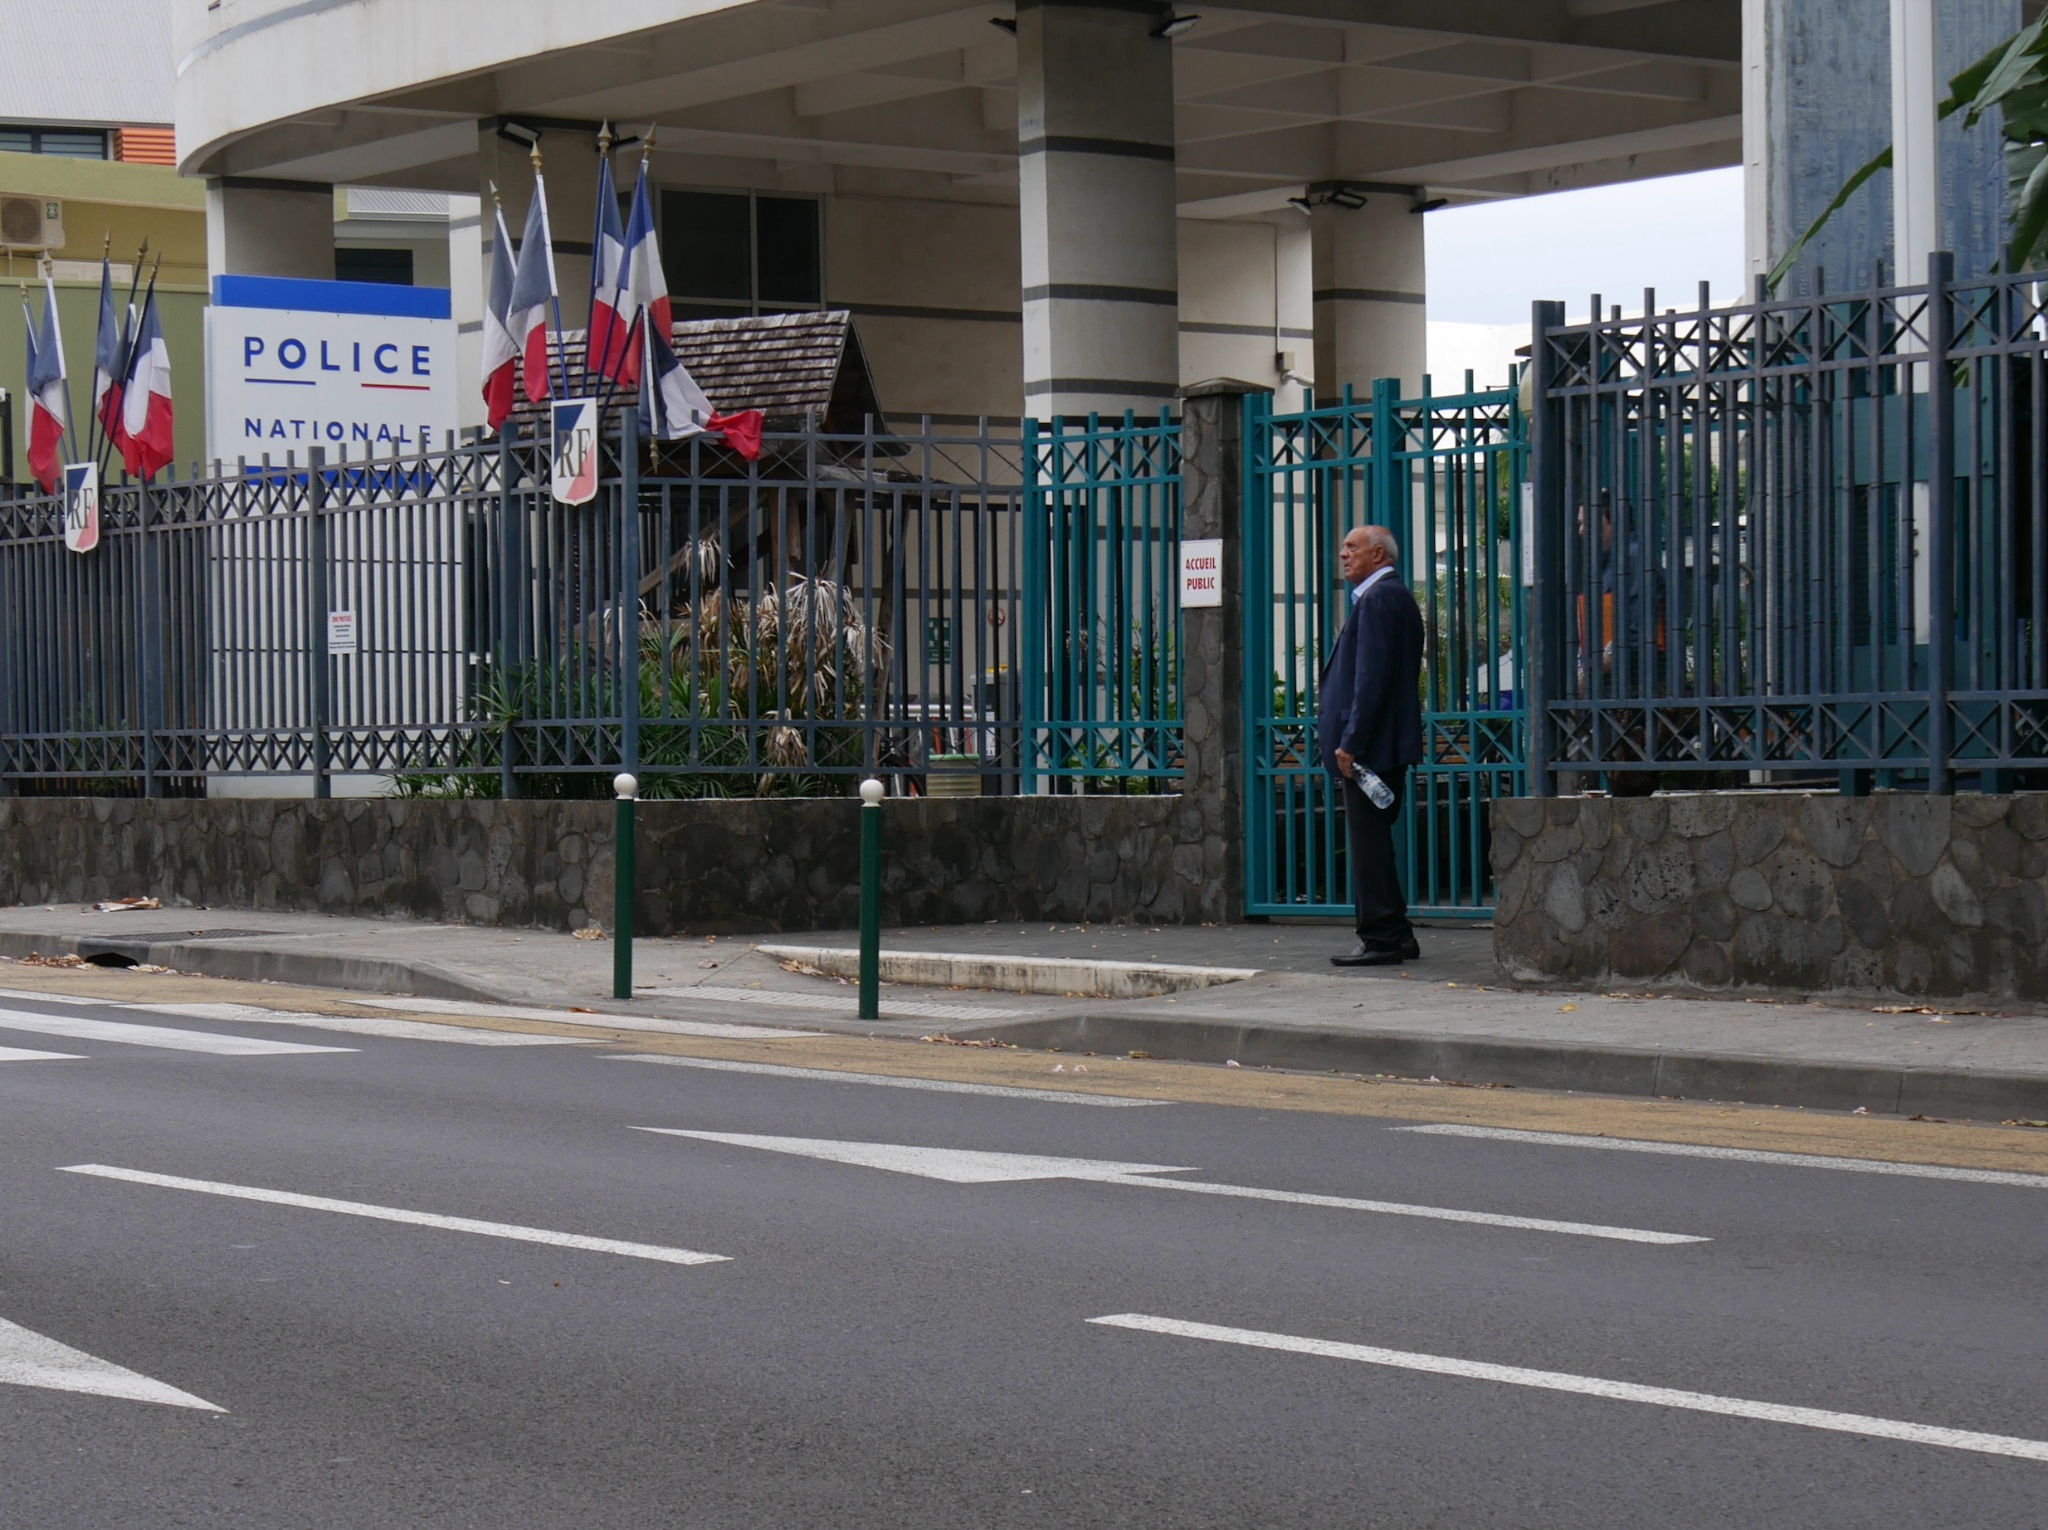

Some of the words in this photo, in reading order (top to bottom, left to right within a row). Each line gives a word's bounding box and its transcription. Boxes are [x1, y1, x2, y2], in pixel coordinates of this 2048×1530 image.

[244, 336, 431, 376] POLICE
[244, 417, 431, 444] NATIONALE
[558, 428, 591, 478] RF
[69, 487, 94, 530] RF
[1185, 557, 1217, 571] ACCUEIL
[1186, 577, 1215, 590] PUBLIC
